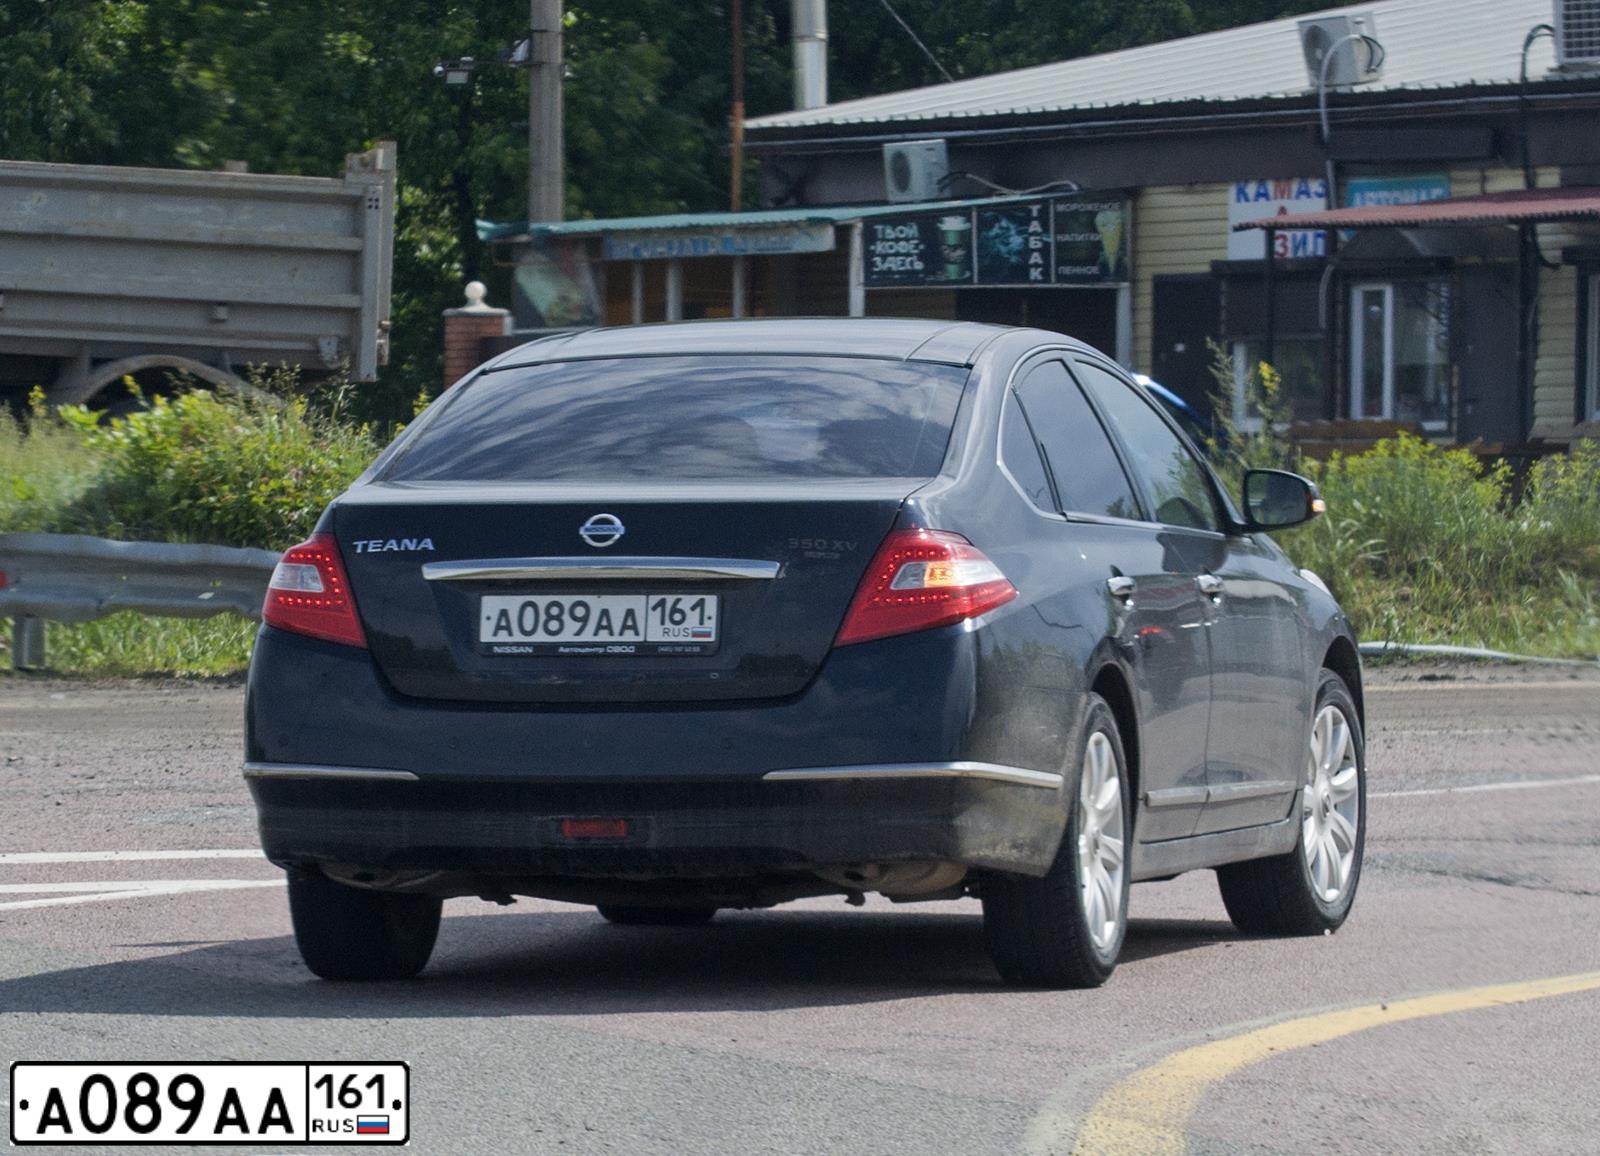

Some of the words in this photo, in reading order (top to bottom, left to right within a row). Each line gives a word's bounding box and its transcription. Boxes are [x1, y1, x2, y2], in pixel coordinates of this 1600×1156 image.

[1235, 180, 1328, 202] КАМАЗ
[873, 222, 919, 239] ТВОЙ
[875, 240, 920, 254] КОФЕ
[1028, 204, 1043, 280] ТАБАК
[872, 256, 924, 272] ЗДЕСЬ
[352, 538, 436, 554] TEANA
[832, 540, 858, 551] XV
[651, 598, 706, 626] 161
[662, 628, 690, 638] RUS
[493, 646, 533, 654] NISSAN
